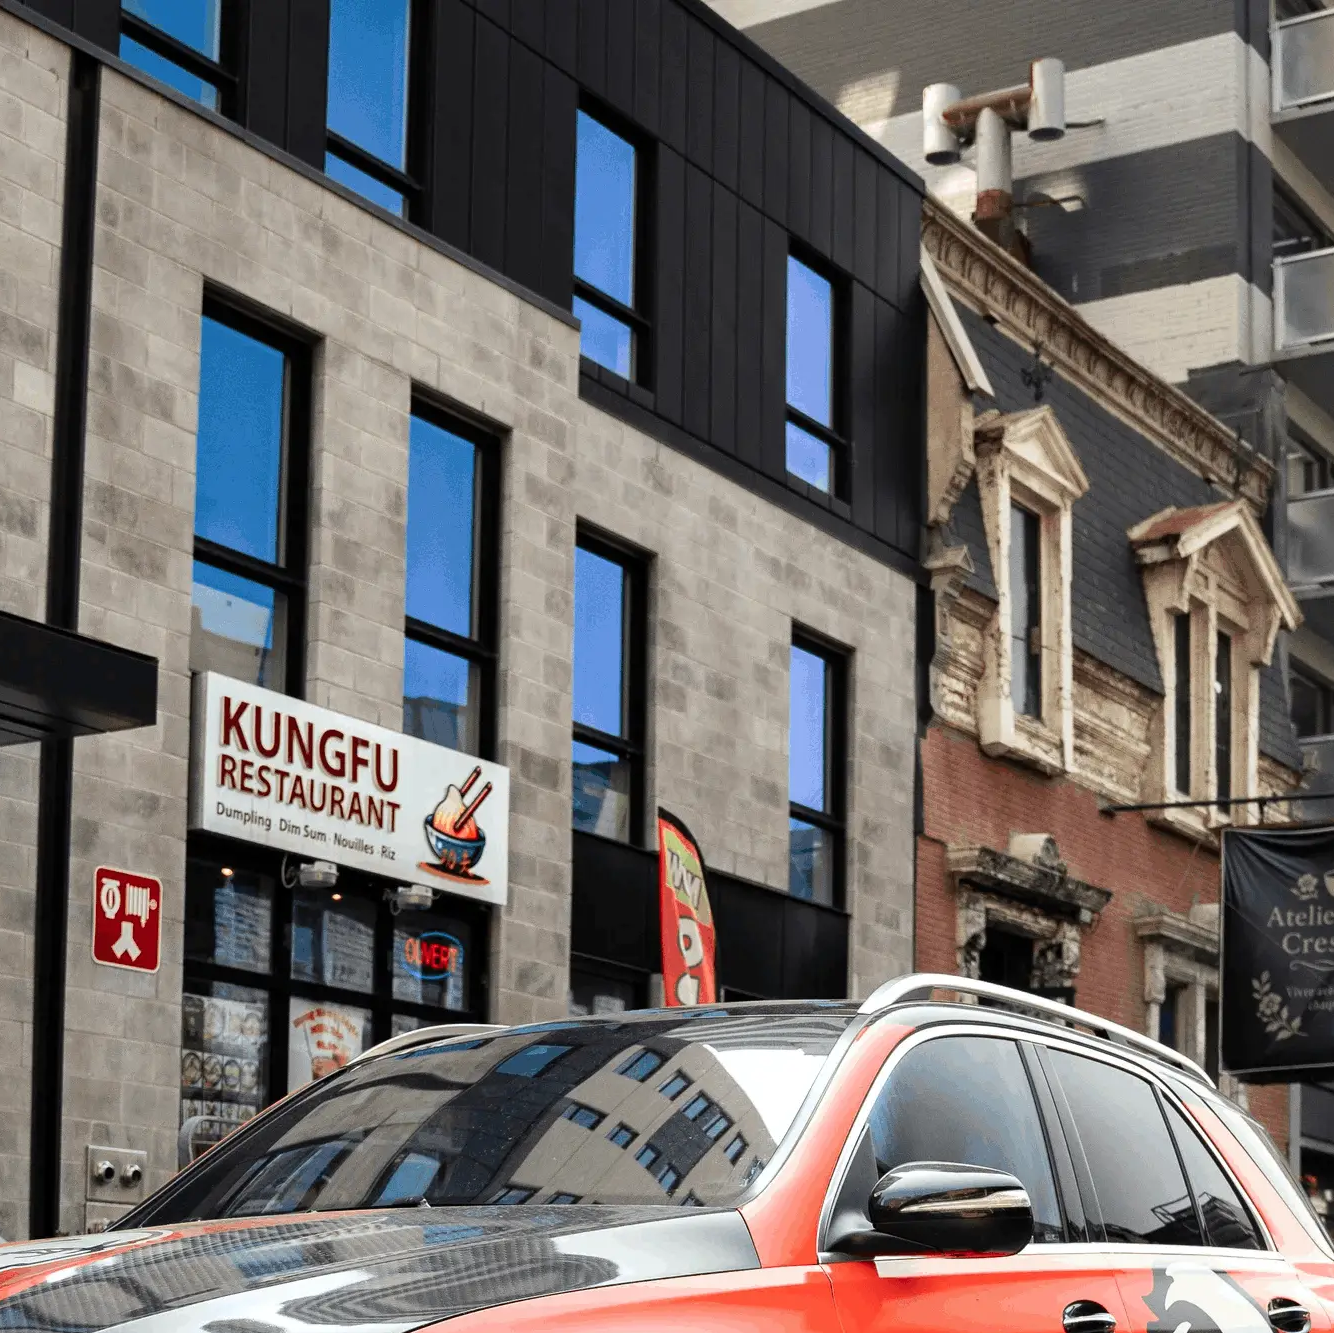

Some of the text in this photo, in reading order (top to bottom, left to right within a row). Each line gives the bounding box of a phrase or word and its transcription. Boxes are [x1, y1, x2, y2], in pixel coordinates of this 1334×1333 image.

[219, 695, 400, 793] KUNGFU
[218, 753, 401, 834] RESTAURANT
[216, 802, 396, 861] Dumpling Dim Sum Nouilles Riz
[404, 936, 458, 973] OUVERT
